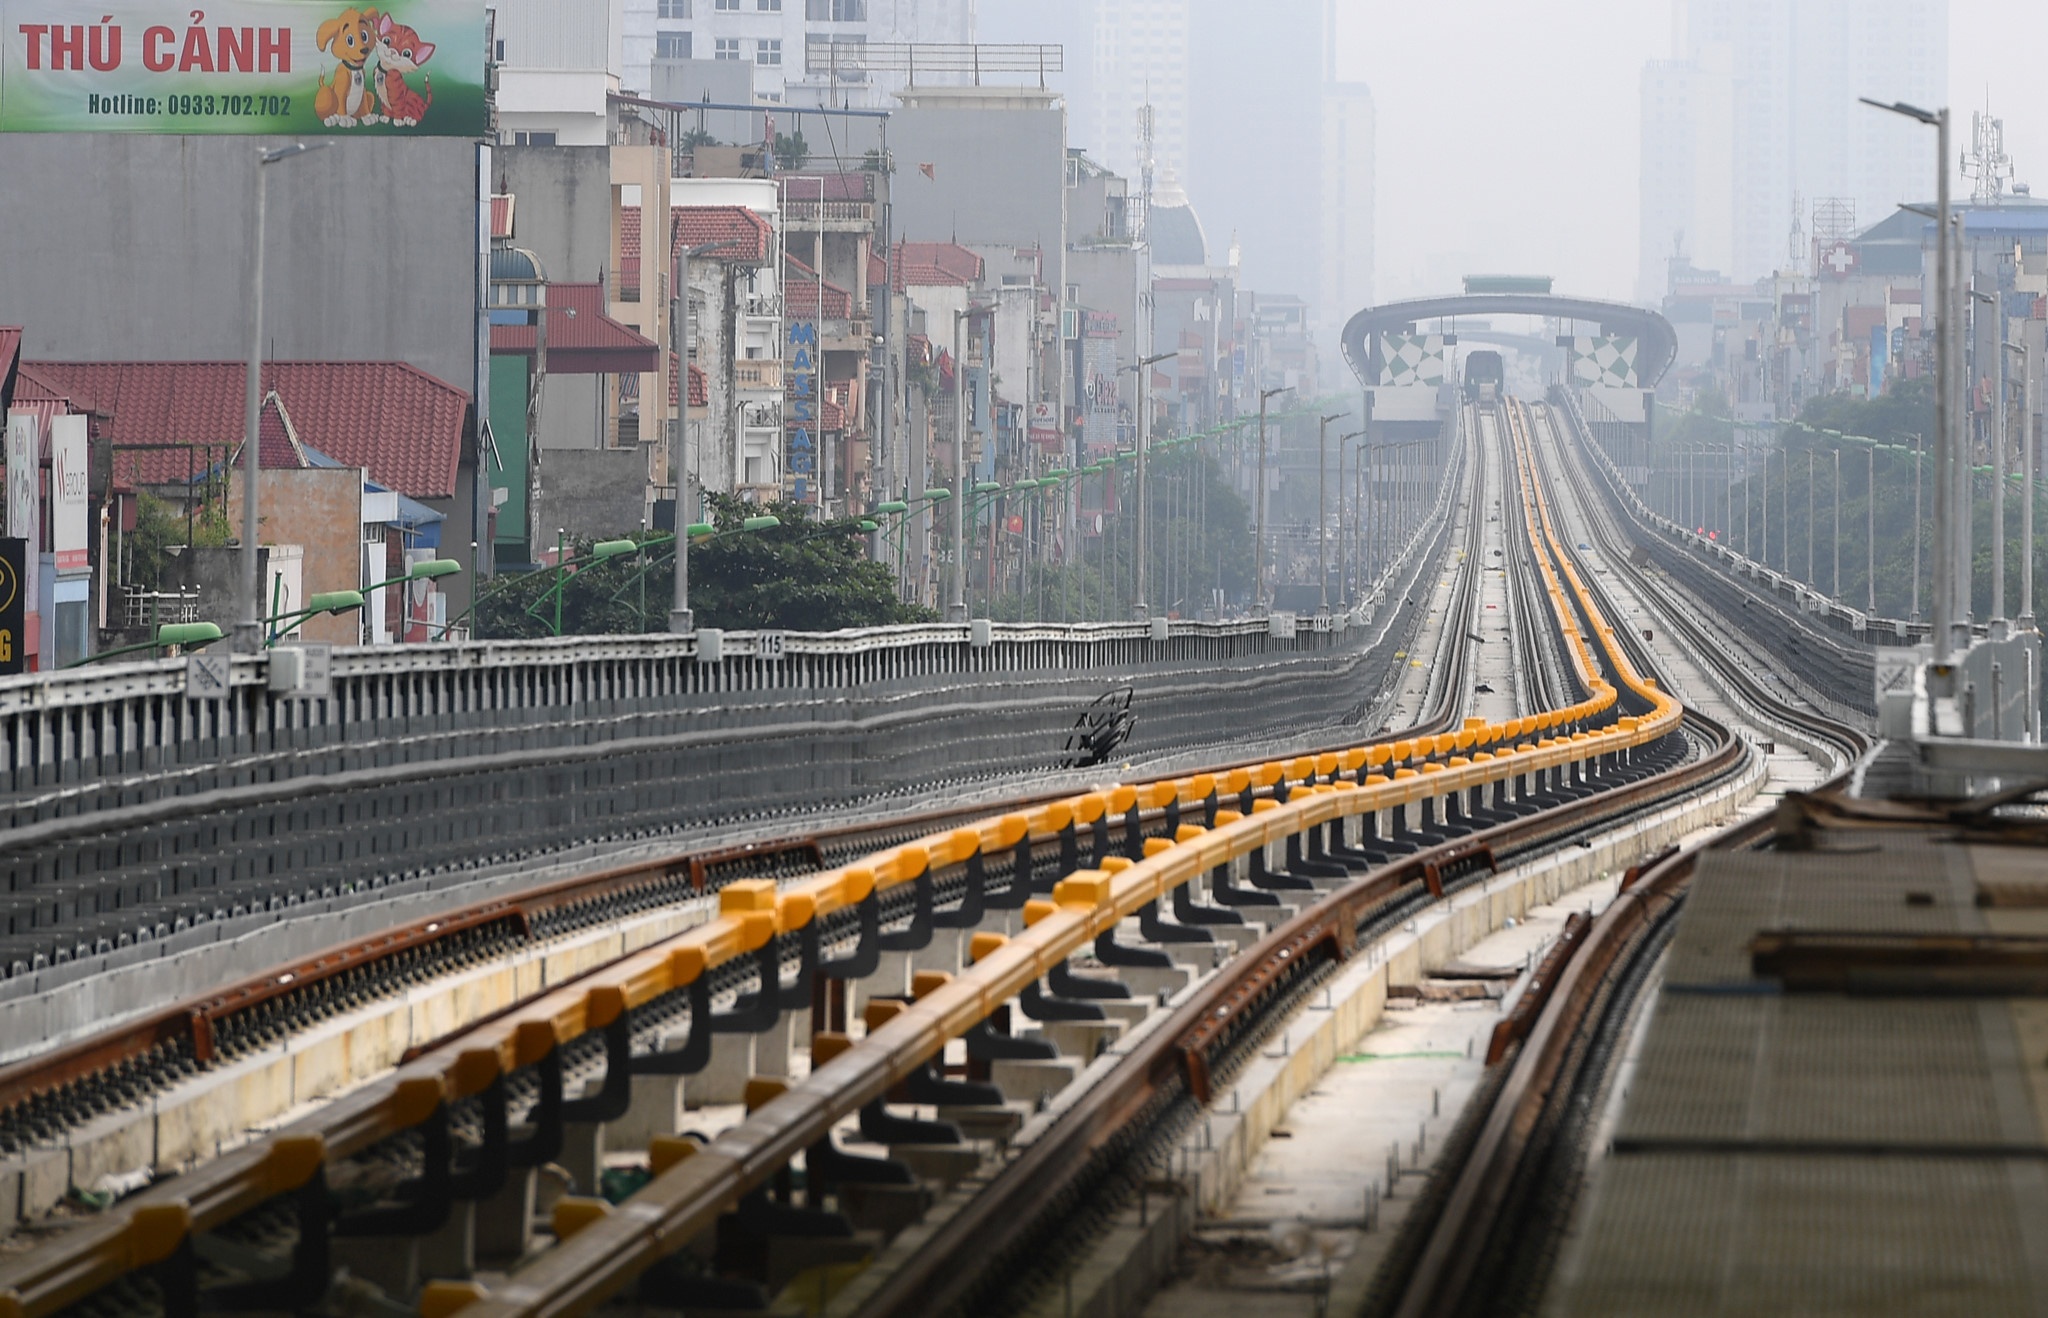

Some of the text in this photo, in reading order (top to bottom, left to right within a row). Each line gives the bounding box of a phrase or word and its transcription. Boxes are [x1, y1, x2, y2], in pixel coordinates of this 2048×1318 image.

[19, 10, 291, 73] THÚ CẢNH
[88, 93, 291, 116] Hotline: 0933.702.702
[789, 322, 815, 500] MASSAGE
[761, 634, 781, 654] 115
